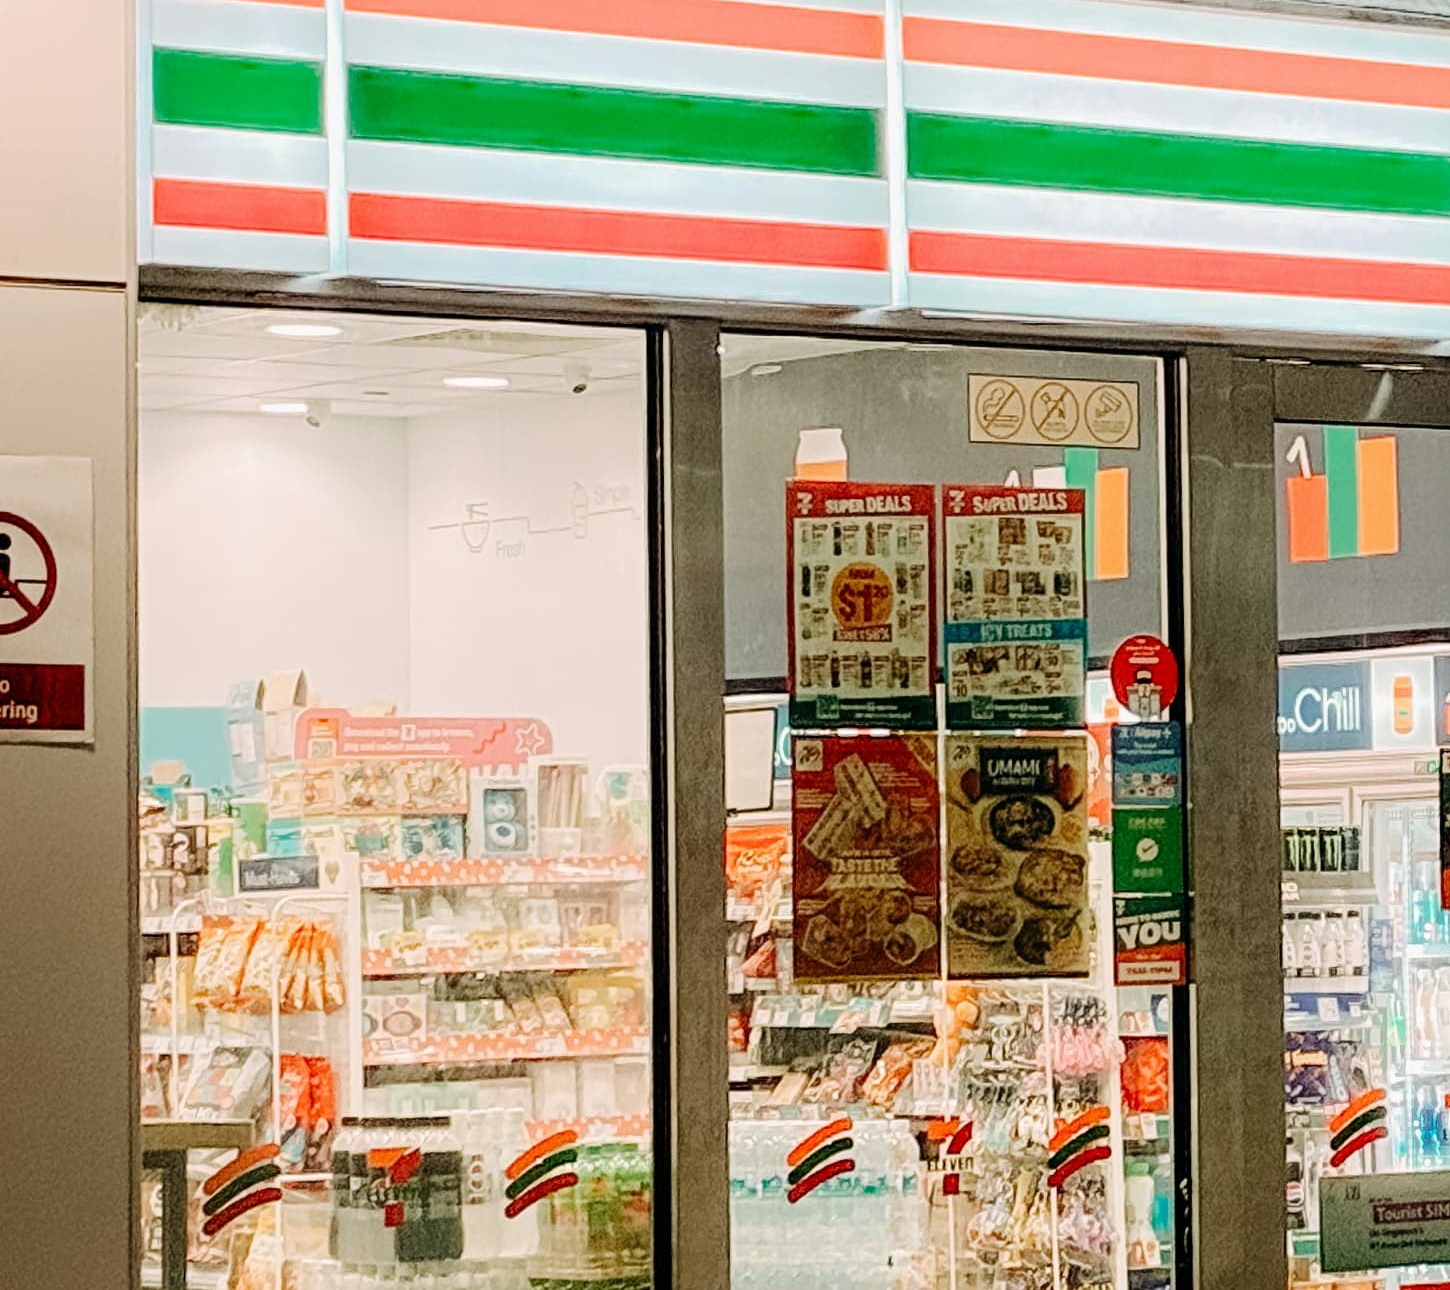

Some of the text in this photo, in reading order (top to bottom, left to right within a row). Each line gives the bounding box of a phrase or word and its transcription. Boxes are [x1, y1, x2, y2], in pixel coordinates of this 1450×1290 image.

[825, 498, 866, 514] SUPER
[867, 494, 912, 513] DEALS
[972, 495, 1017, 513] SUPER
[1018, 491, 1068, 512] DEALS
[1006, 623, 1053, 639] TREATS
[0, 679, 10, 694] o
[0, 699, 38, 725] ring
[988, 759, 1041, 778] UMAMI
[1116, 920, 1181, 950] YOU
[1376, 1203, 1450, 1223] Tourist SIM
